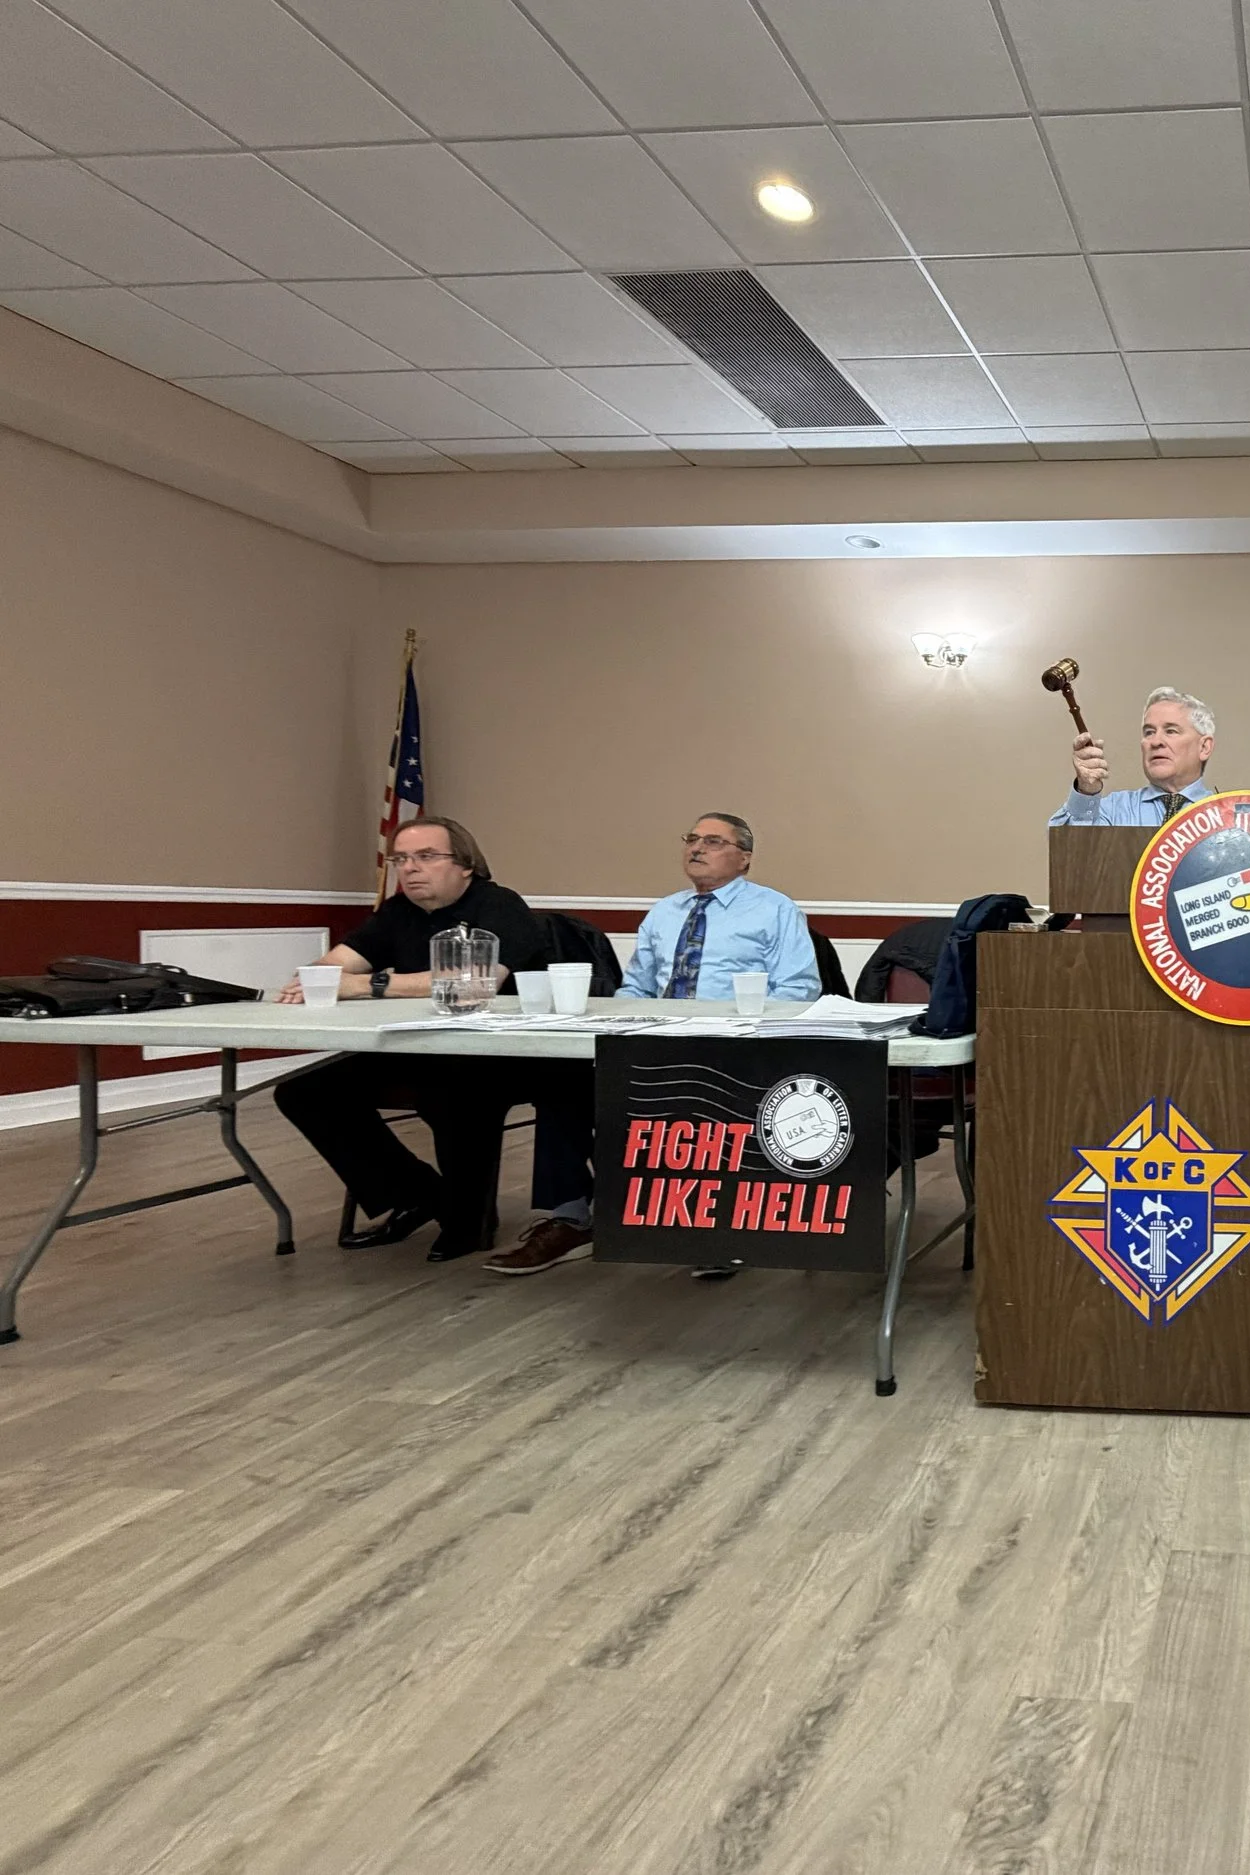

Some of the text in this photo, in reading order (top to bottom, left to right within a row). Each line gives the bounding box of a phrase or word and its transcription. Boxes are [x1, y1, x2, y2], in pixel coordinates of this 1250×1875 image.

[1141, 806, 1225, 909] ASSOCIATION
[1180, 889, 1232, 914] LONG ISLAND
[1184, 908, 1220, 927] MERGED
[1189, 915, 1250, 942] BRANCH 6000
[1143, 915, 1207, 1001] NATIONAL
[623, 1120, 754, 1172] FIGHT
[764, 1085, 848, 1166] NATIONAL ASSOCIATION OF LETTER CARRIERS
[1114, 1157, 1138, 1183] K
[1184, 1159, 1205, 1184] C
[622, 1177, 852, 1234] LIKE HELL!
